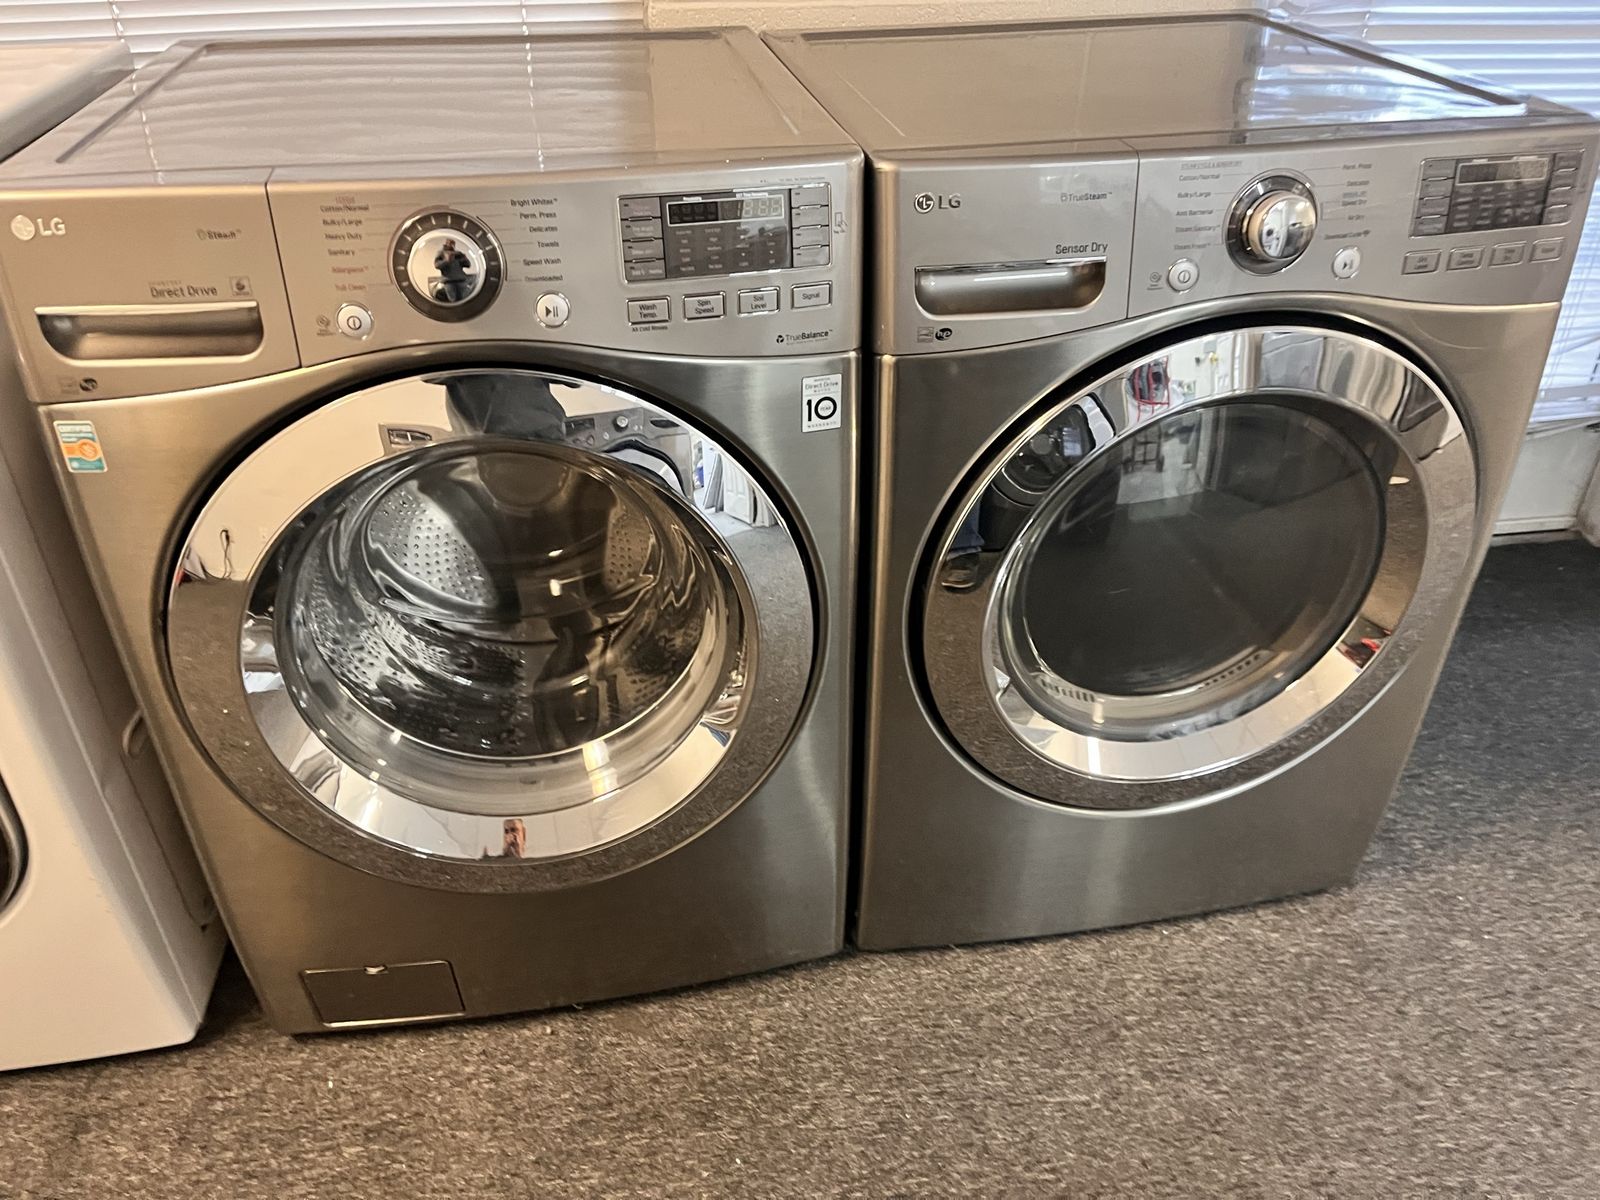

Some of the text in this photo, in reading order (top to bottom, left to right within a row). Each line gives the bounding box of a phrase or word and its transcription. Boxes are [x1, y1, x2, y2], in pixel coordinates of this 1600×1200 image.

[510, 199, 530, 207] Bright
[938, 194, 961, 210] LG
[37, 217, 66, 236] LG
[1055, 241, 1108, 255] Sensor Dry
[150, 285, 218, 298] Direct Drive
[801, 293, 821, 301] Signal
[695, 307, 715, 315] Speed
[807, 396, 837, 422] 10
